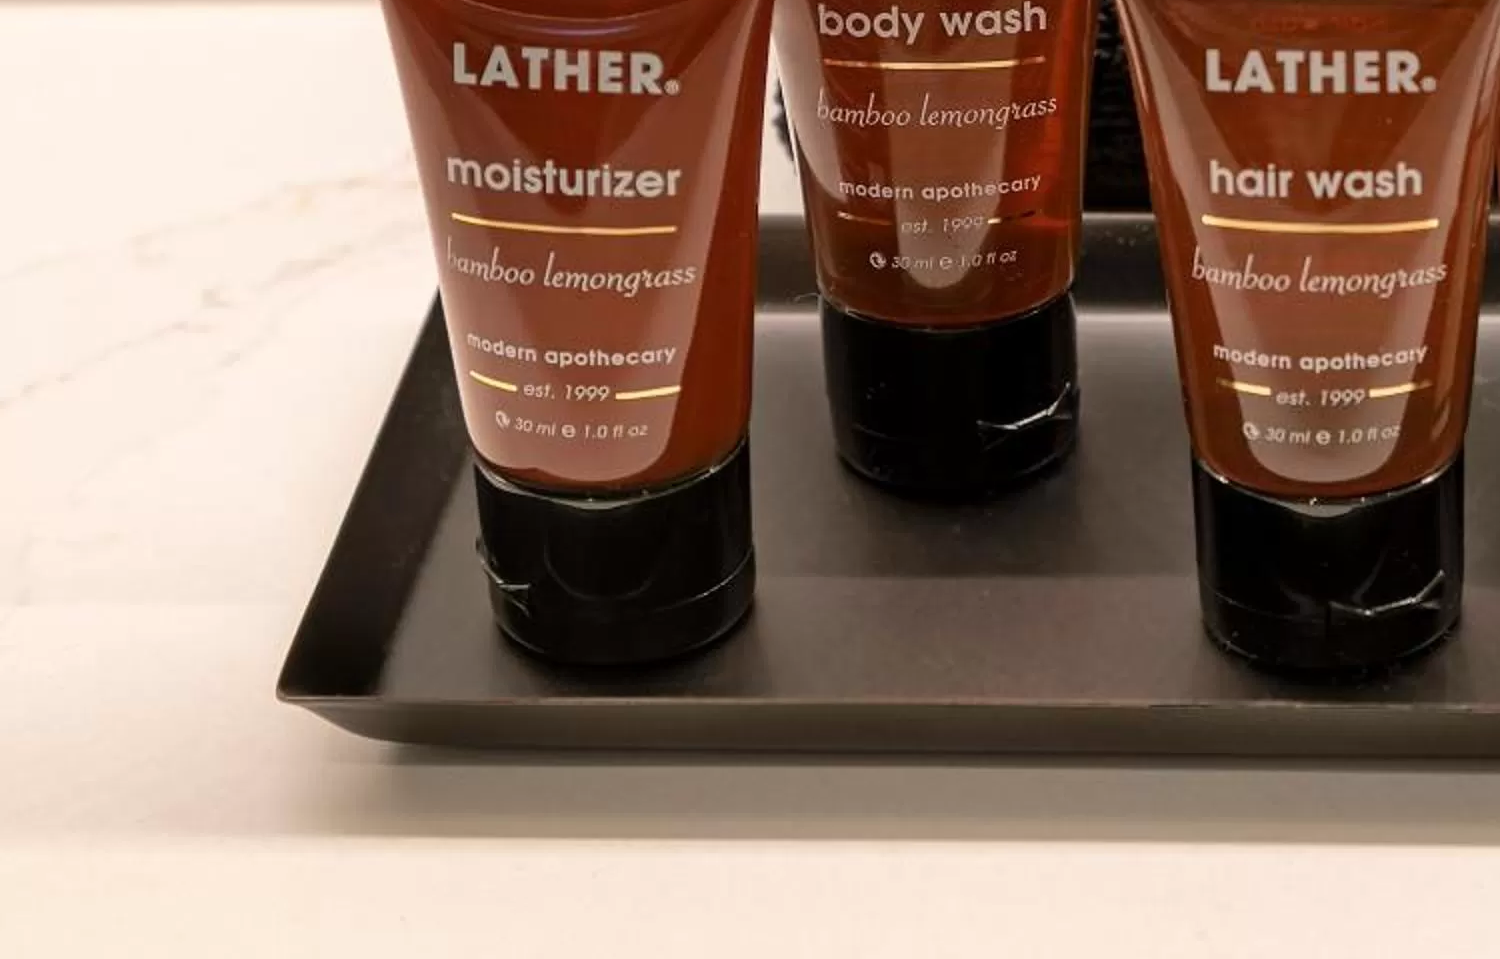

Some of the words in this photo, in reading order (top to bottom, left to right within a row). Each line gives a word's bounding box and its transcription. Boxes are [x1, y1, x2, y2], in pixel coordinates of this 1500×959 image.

[817, 2, 924, 44] body
[940, 0, 1046, 37] wash
[817, 86, 911, 127] bamboo
[919, 92, 1057, 131] lemongrass
[447, 156, 682, 198] moisturizer
[839, 179, 913, 201] modern
[921, 174, 1041, 202] apothecary
[1209, 159, 1293, 198] hair
[1307, 160, 1423, 198] wash
[447, 237, 535, 287] bamboo
[544, 252, 696, 298] lemongrass
[1192, 246, 1291, 292] bamboo
[1300, 256, 1447, 299] lemongrass
[467, 332, 537, 363] modern
[545, 345, 676, 368] apothecary
[1213, 344, 1292, 370] modern
[1299, 344, 1427, 374] apothecary
[565, 384, 610, 401] 1999
[1320, 389, 1366, 407] 1999
[514, 416, 533, 433] 30
[536, 422, 557, 437] ml
[584, 424, 607, 439] 1.0
[627, 424, 648, 437] oz
[1265, 427, 1285, 441] 30
[1289, 428, 1311, 443] ml
[1338, 428, 1362, 444] 1.0
[1381, 425, 1400, 439] oz
